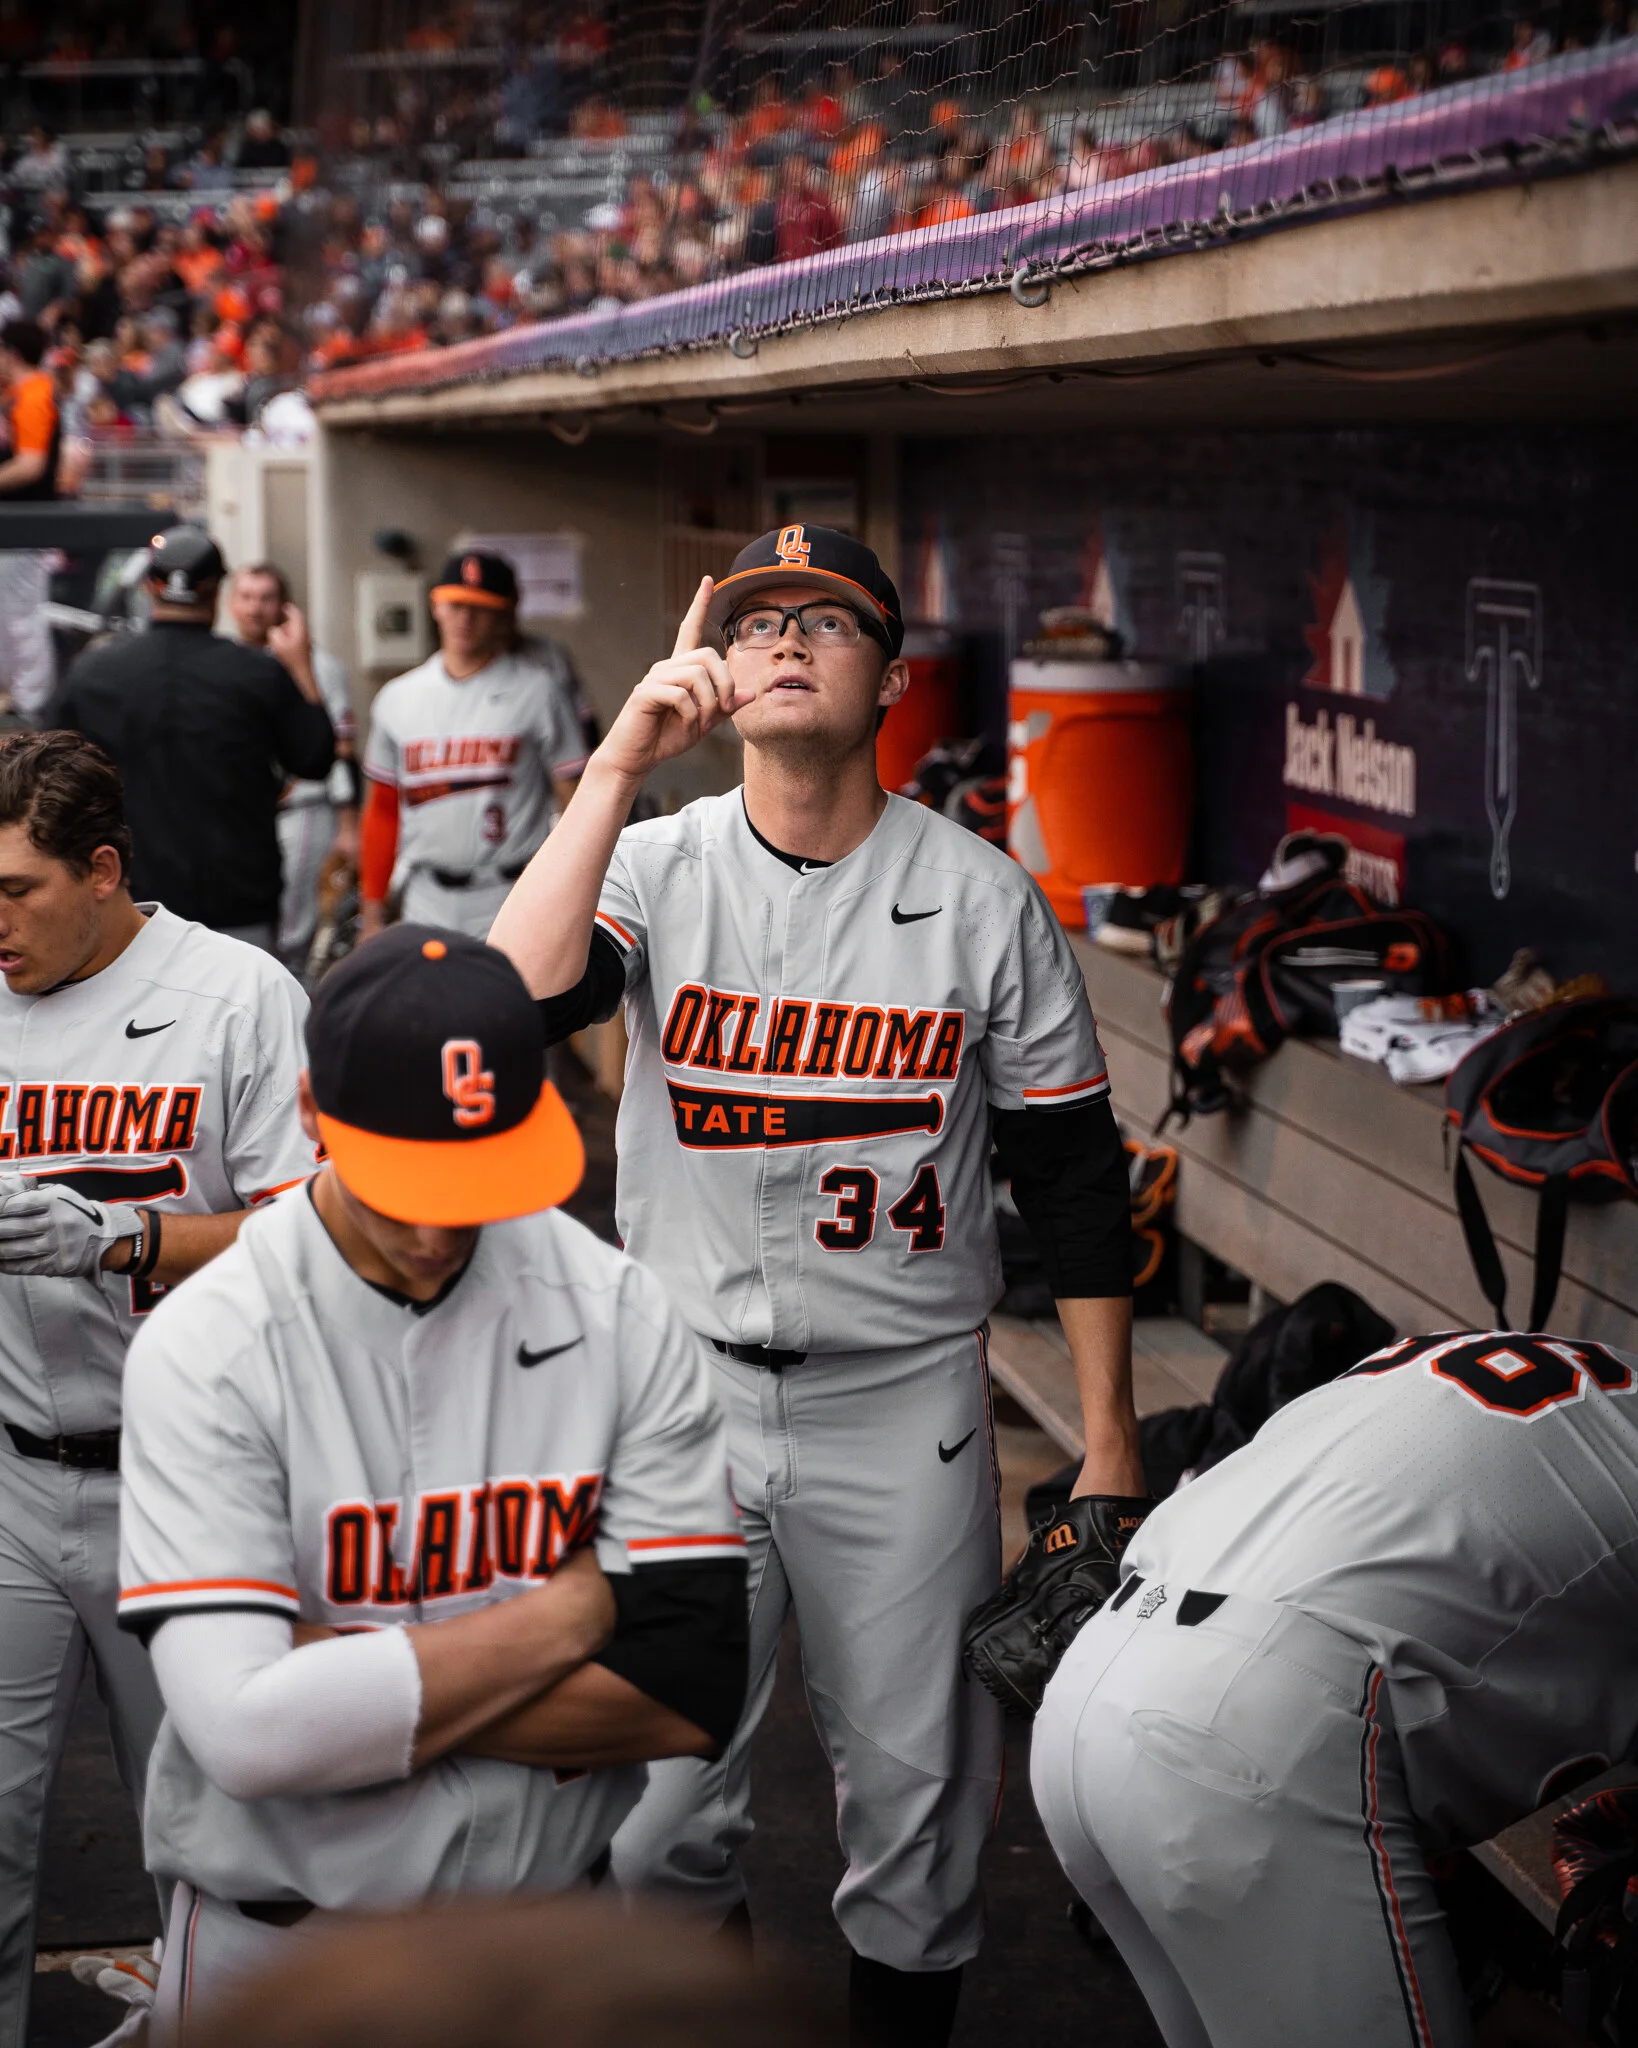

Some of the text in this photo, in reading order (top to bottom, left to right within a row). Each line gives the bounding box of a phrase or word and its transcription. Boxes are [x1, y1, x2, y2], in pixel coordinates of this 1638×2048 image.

[1284, 700, 1416, 818] Jack Nelson
[661, 980, 965, 1082] OKLAHOMA
[441, 1038, 495, 1128] OS
[814, 1163, 946, 1254] 34
